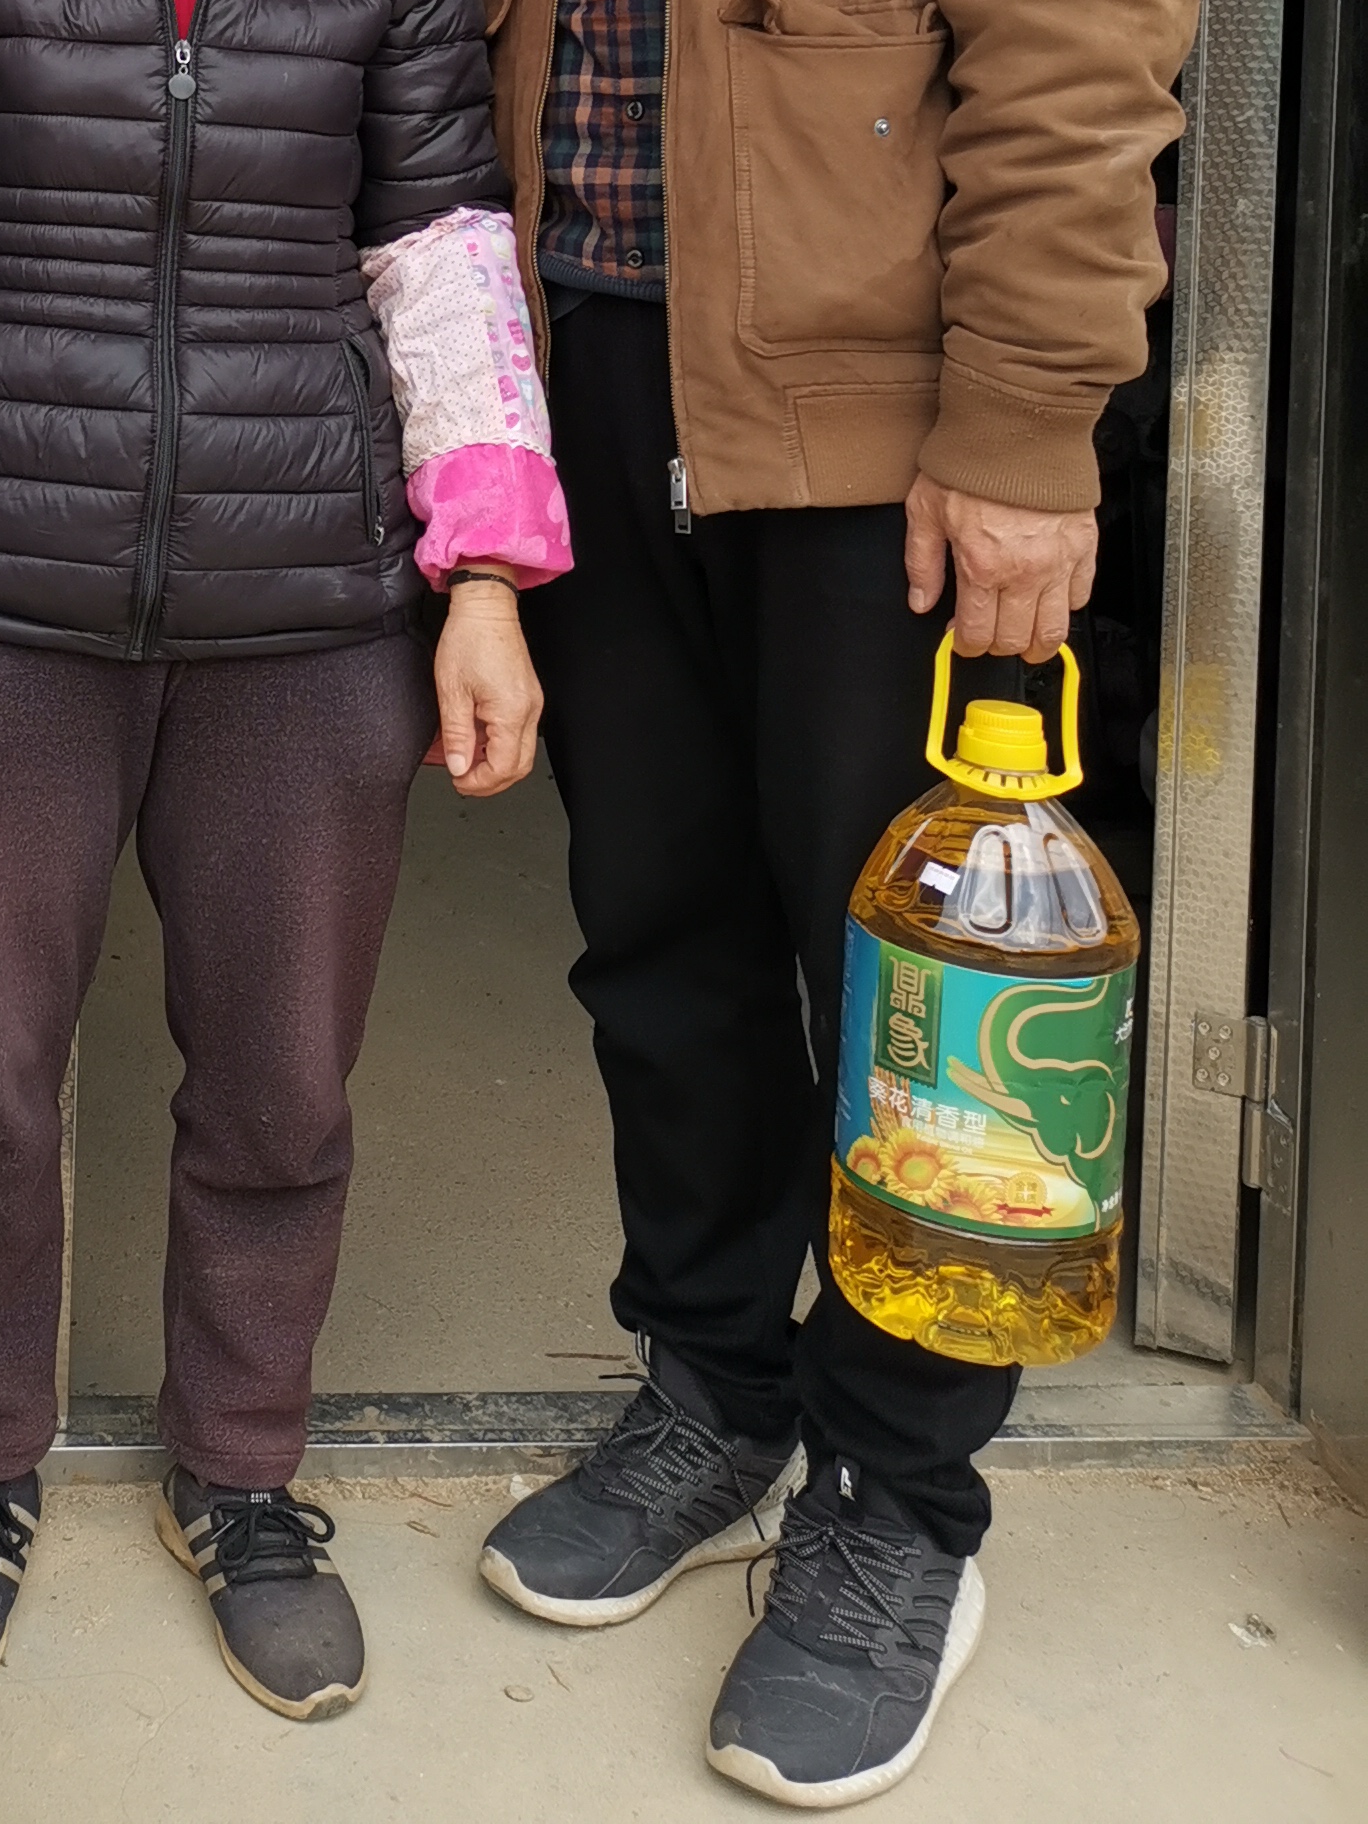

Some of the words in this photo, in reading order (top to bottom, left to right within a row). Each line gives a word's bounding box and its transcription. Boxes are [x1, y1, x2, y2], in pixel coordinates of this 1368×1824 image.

[868, 1076, 987, 1136] 葵花清香型
